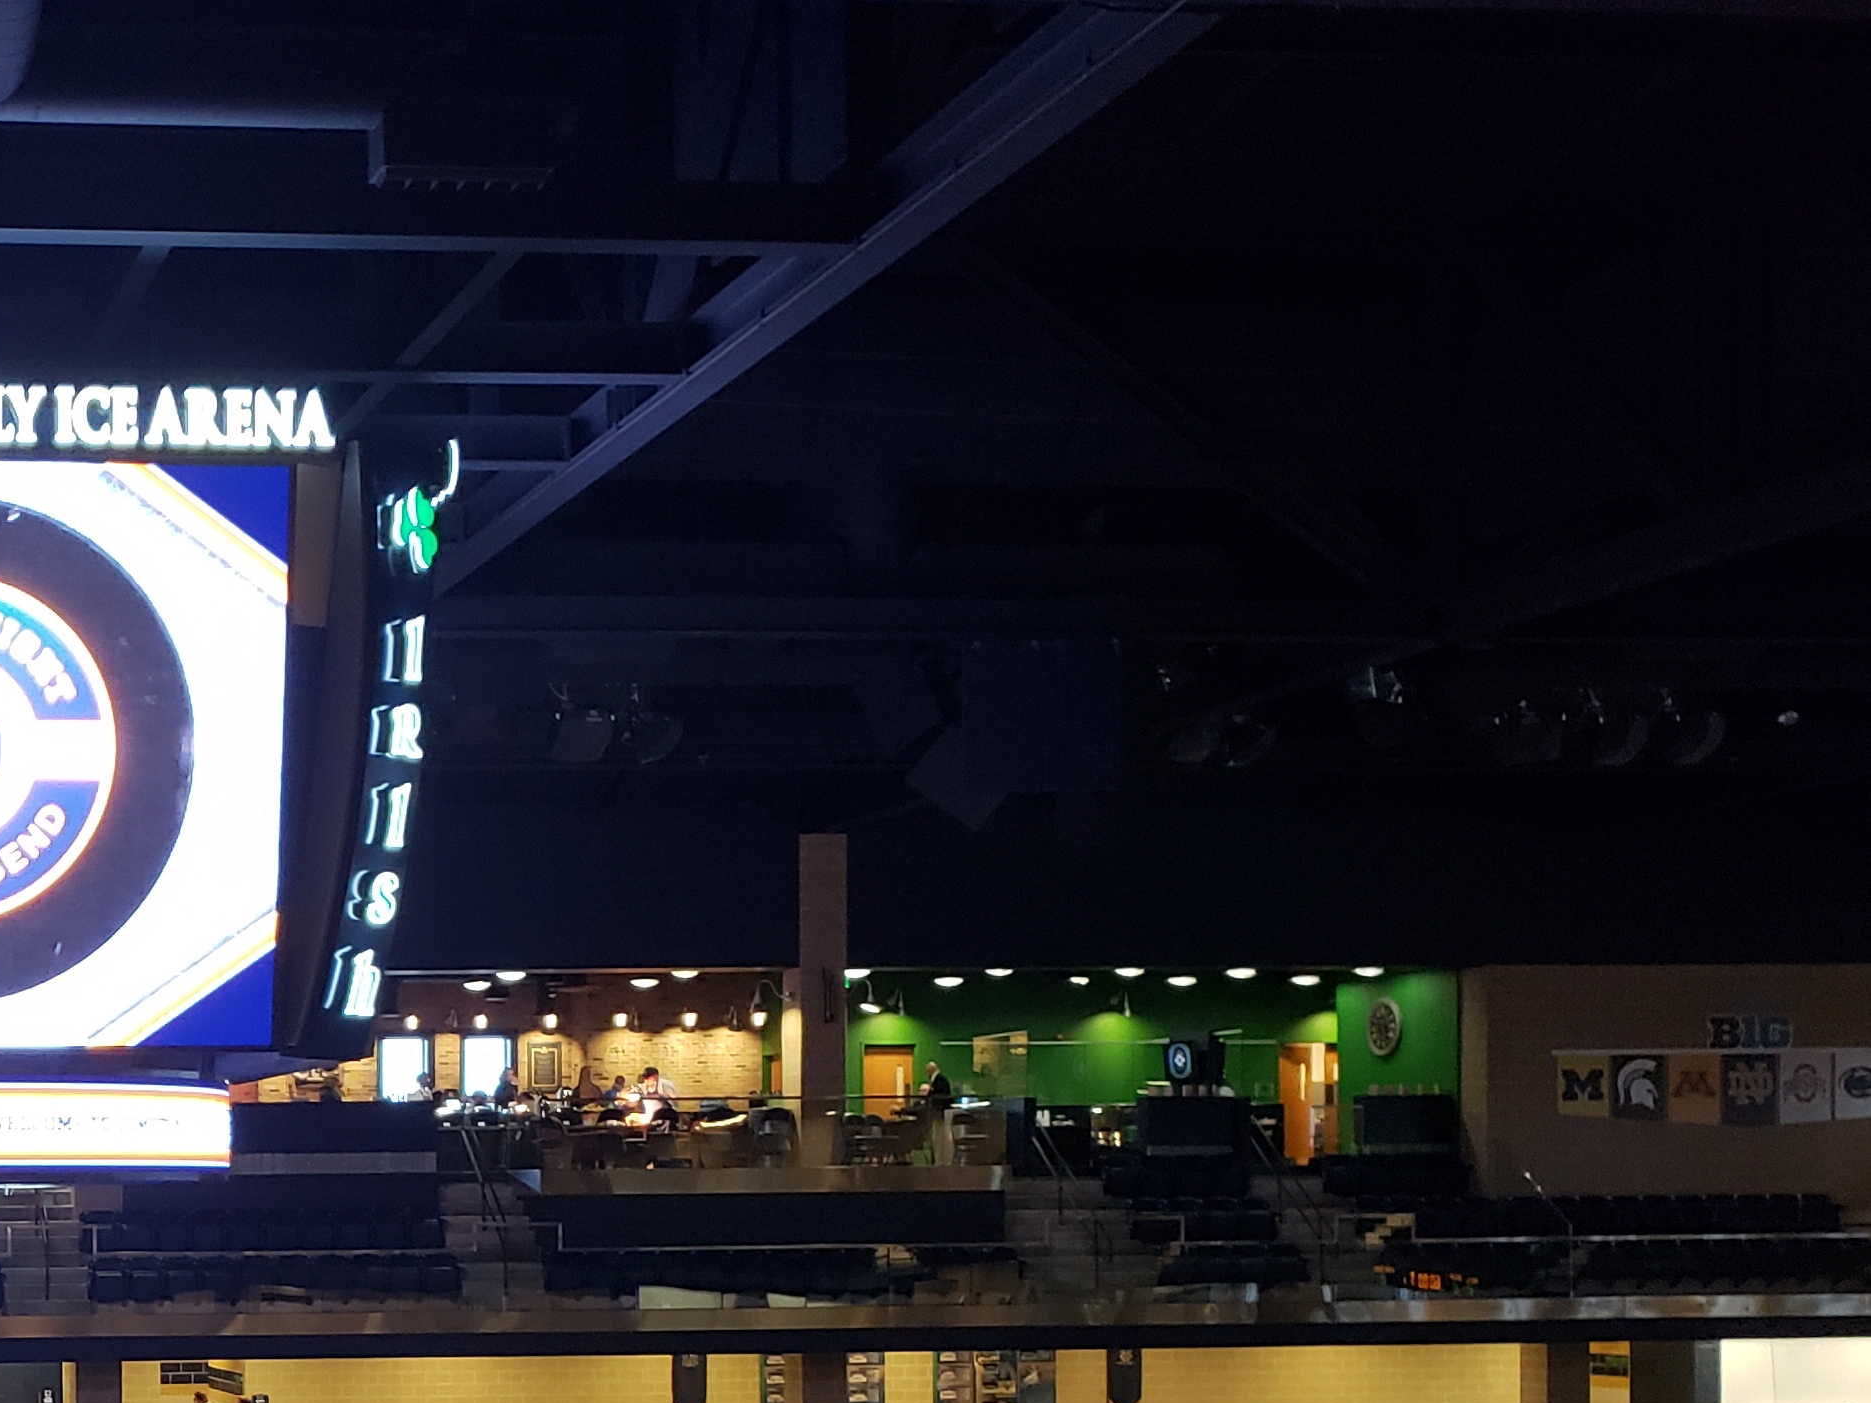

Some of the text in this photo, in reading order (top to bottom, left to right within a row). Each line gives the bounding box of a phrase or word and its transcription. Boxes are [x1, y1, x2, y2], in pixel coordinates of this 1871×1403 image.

[55, 384, 139, 446] ICE
[144, 382, 336, 447] ARENA
[1561, 1068, 1605, 1102] M
